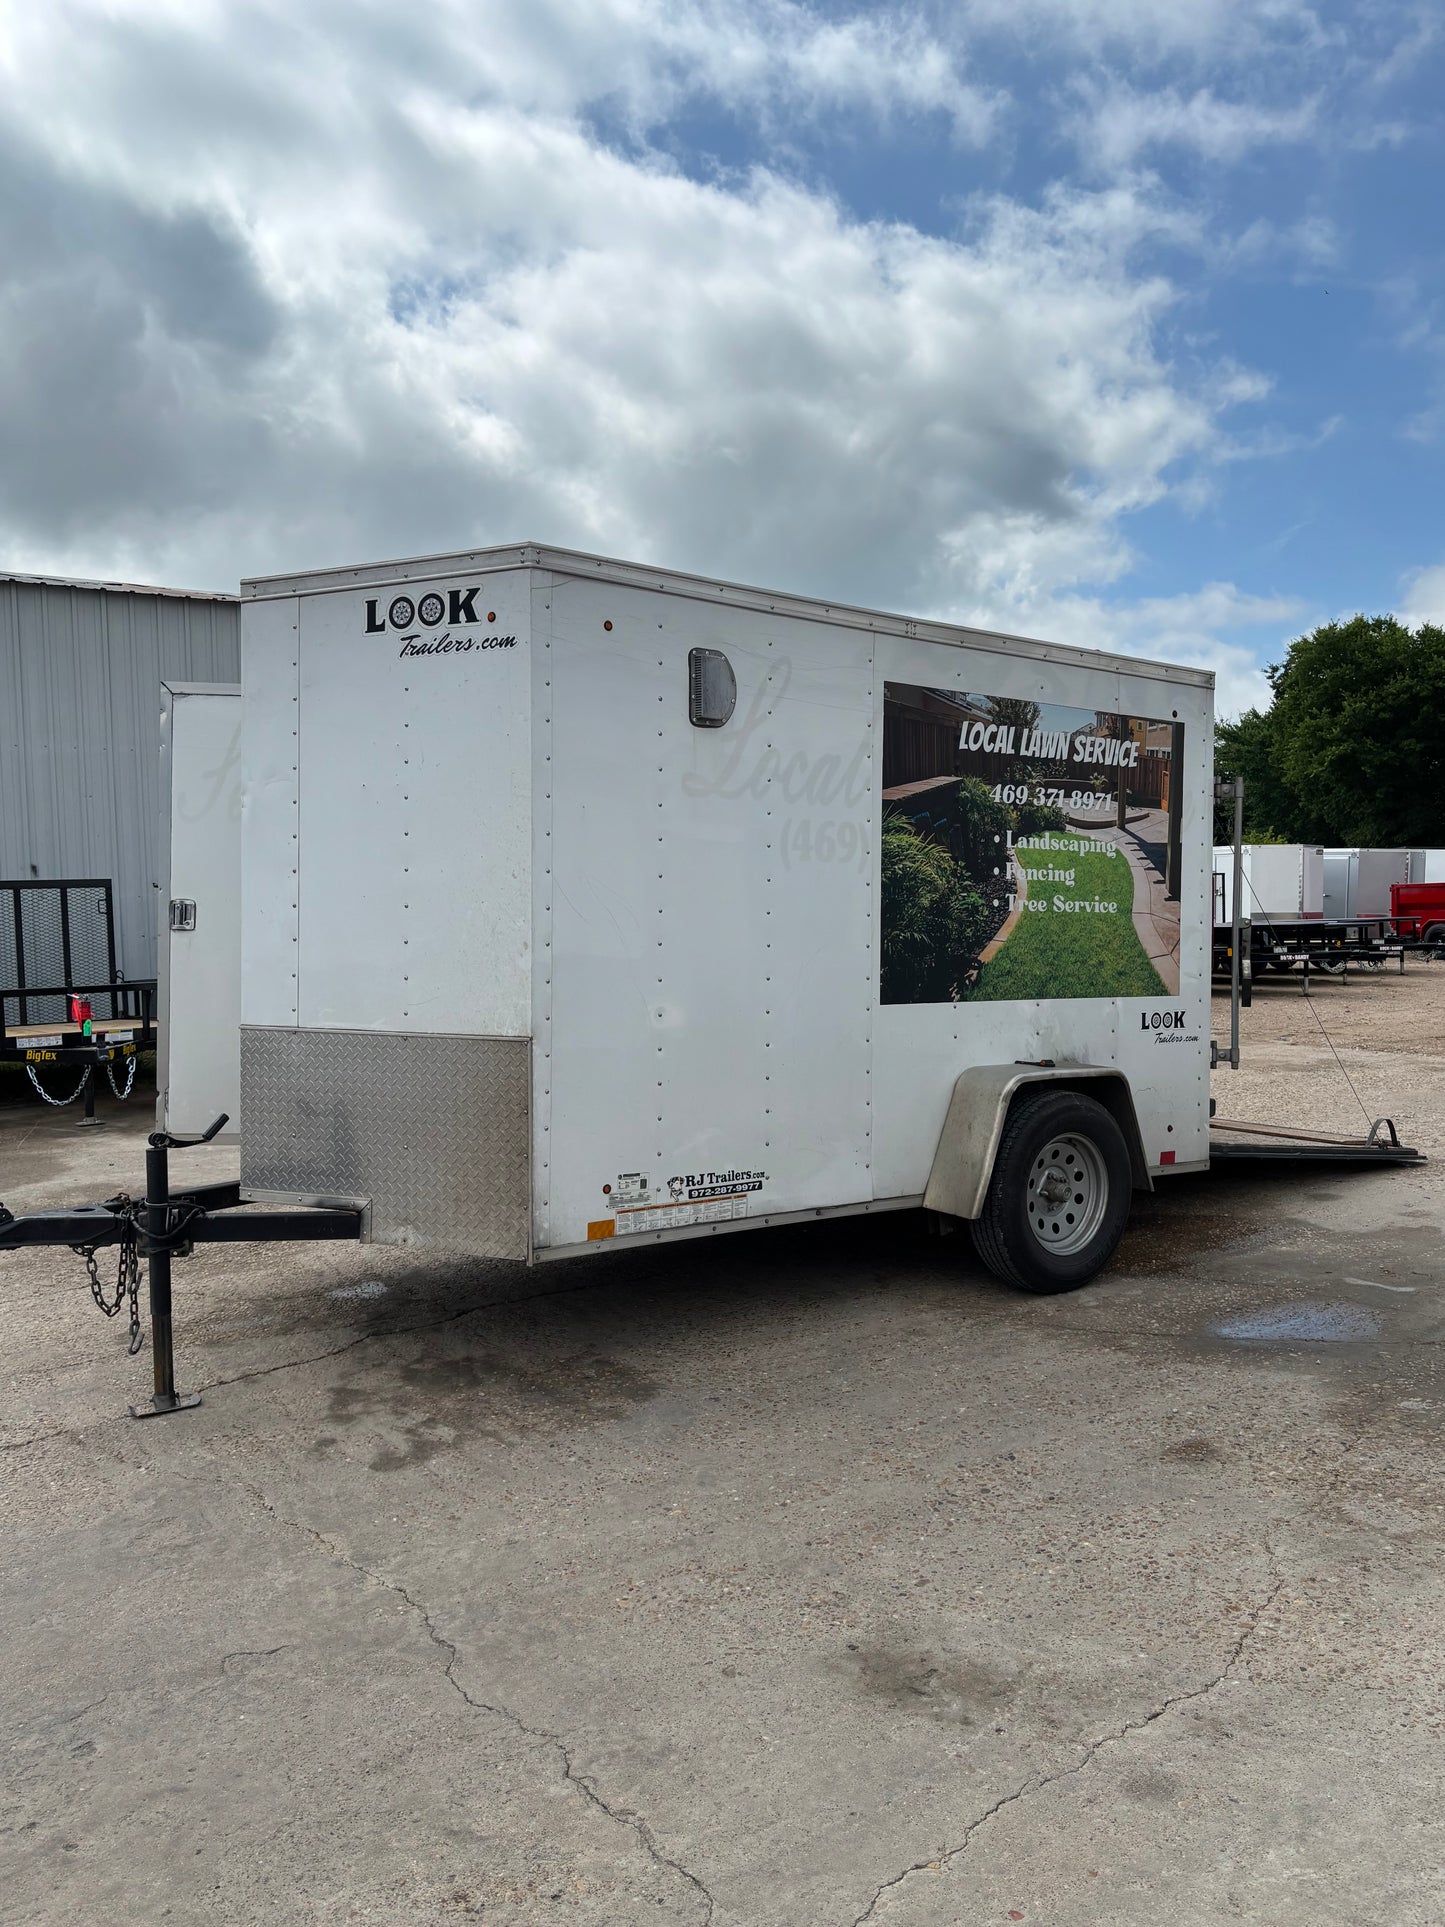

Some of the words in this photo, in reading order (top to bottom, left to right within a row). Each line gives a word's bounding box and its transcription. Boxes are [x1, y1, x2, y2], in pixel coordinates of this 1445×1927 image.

[365, 587, 481, 634] LOOK
[399, 632, 517, 658] Trailers.com
[959, 720, 1015, 755] LOCAL
[1019, 728, 1071, 760] LAWN
[1073, 734, 1140, 768] SERVICE
[1006, 830, 1116, 859] Landscaping
[1005, 862, 1075, 887] Fencing
[1005, 893, 1048, 912] Tree
[1052, 894, 1118, 913] Service
[1141, 1011, 1185, 1030] LOOK
[26, 1050, 57, 1062] BigTex
[685, 1174, 706, 1187] RJ
[691, 1182, 760, 1198] 972-287-9977
